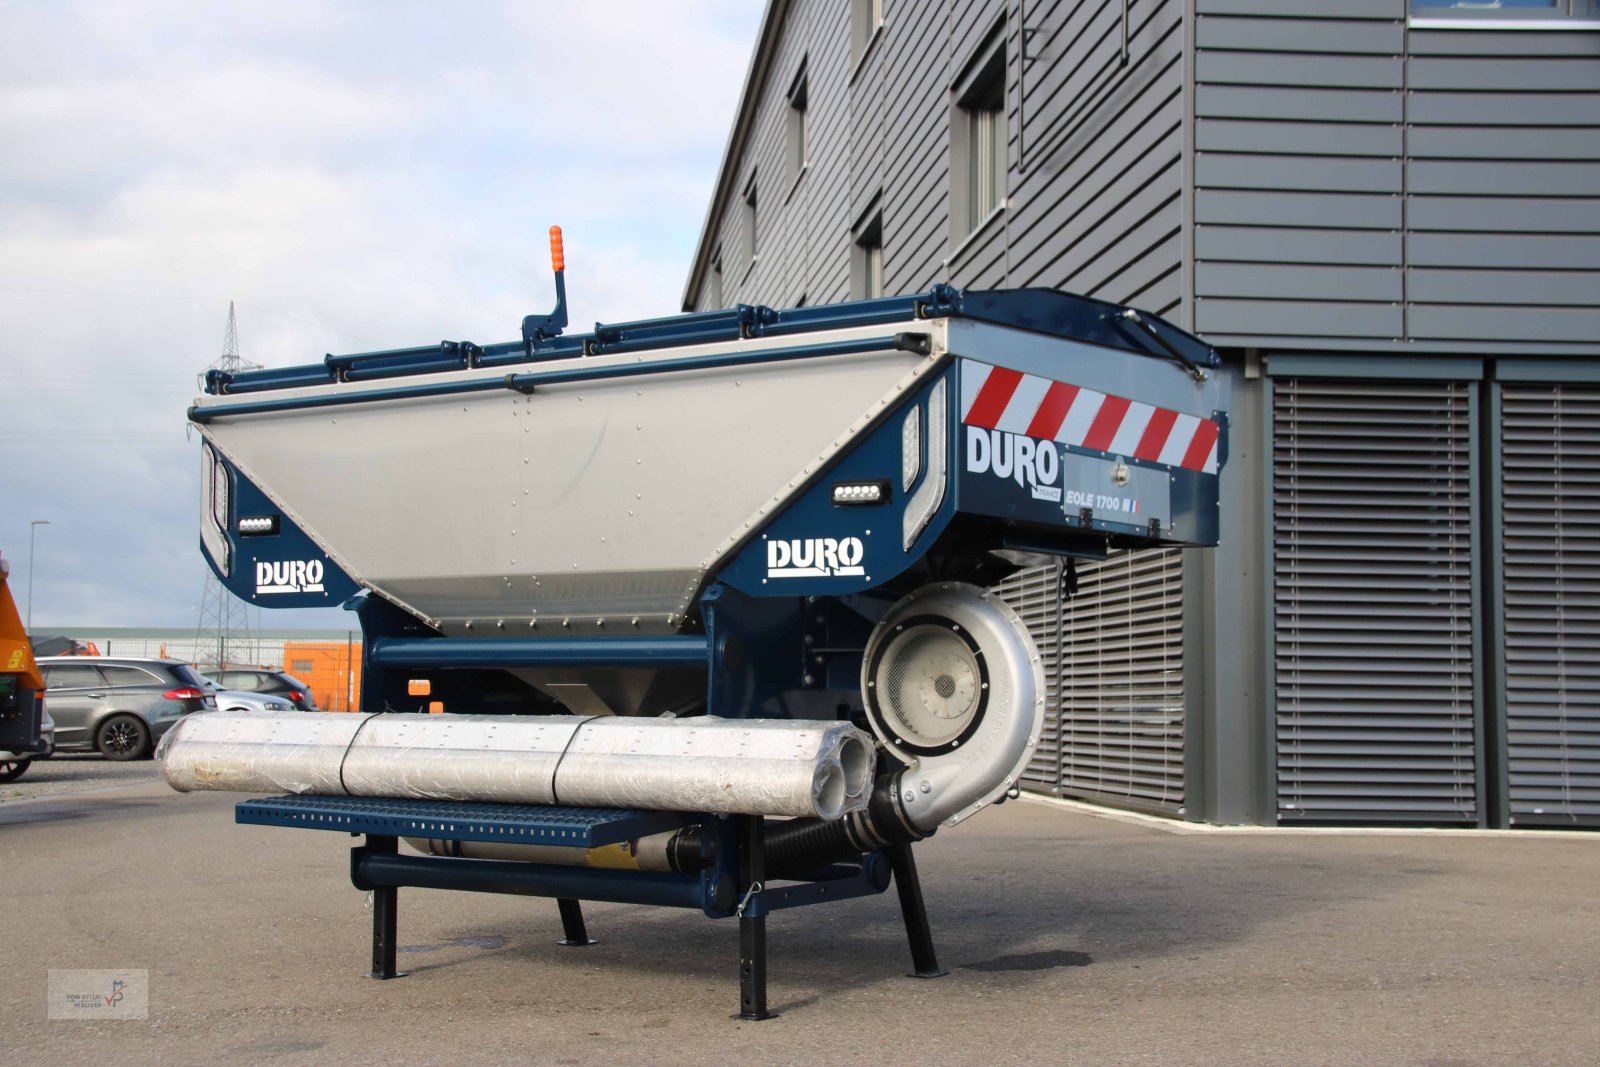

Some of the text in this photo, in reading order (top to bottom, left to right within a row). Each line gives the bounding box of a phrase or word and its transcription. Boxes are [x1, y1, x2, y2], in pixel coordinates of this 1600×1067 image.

[967, 425, 1059, 491] DURO
[1039, 489, 1059, 499] FRANCE
[1066, 490, 1120, 510] EOLE 1700
[767, 537, 864, 573] DURO
[256, 559, 324, 589] DURO
